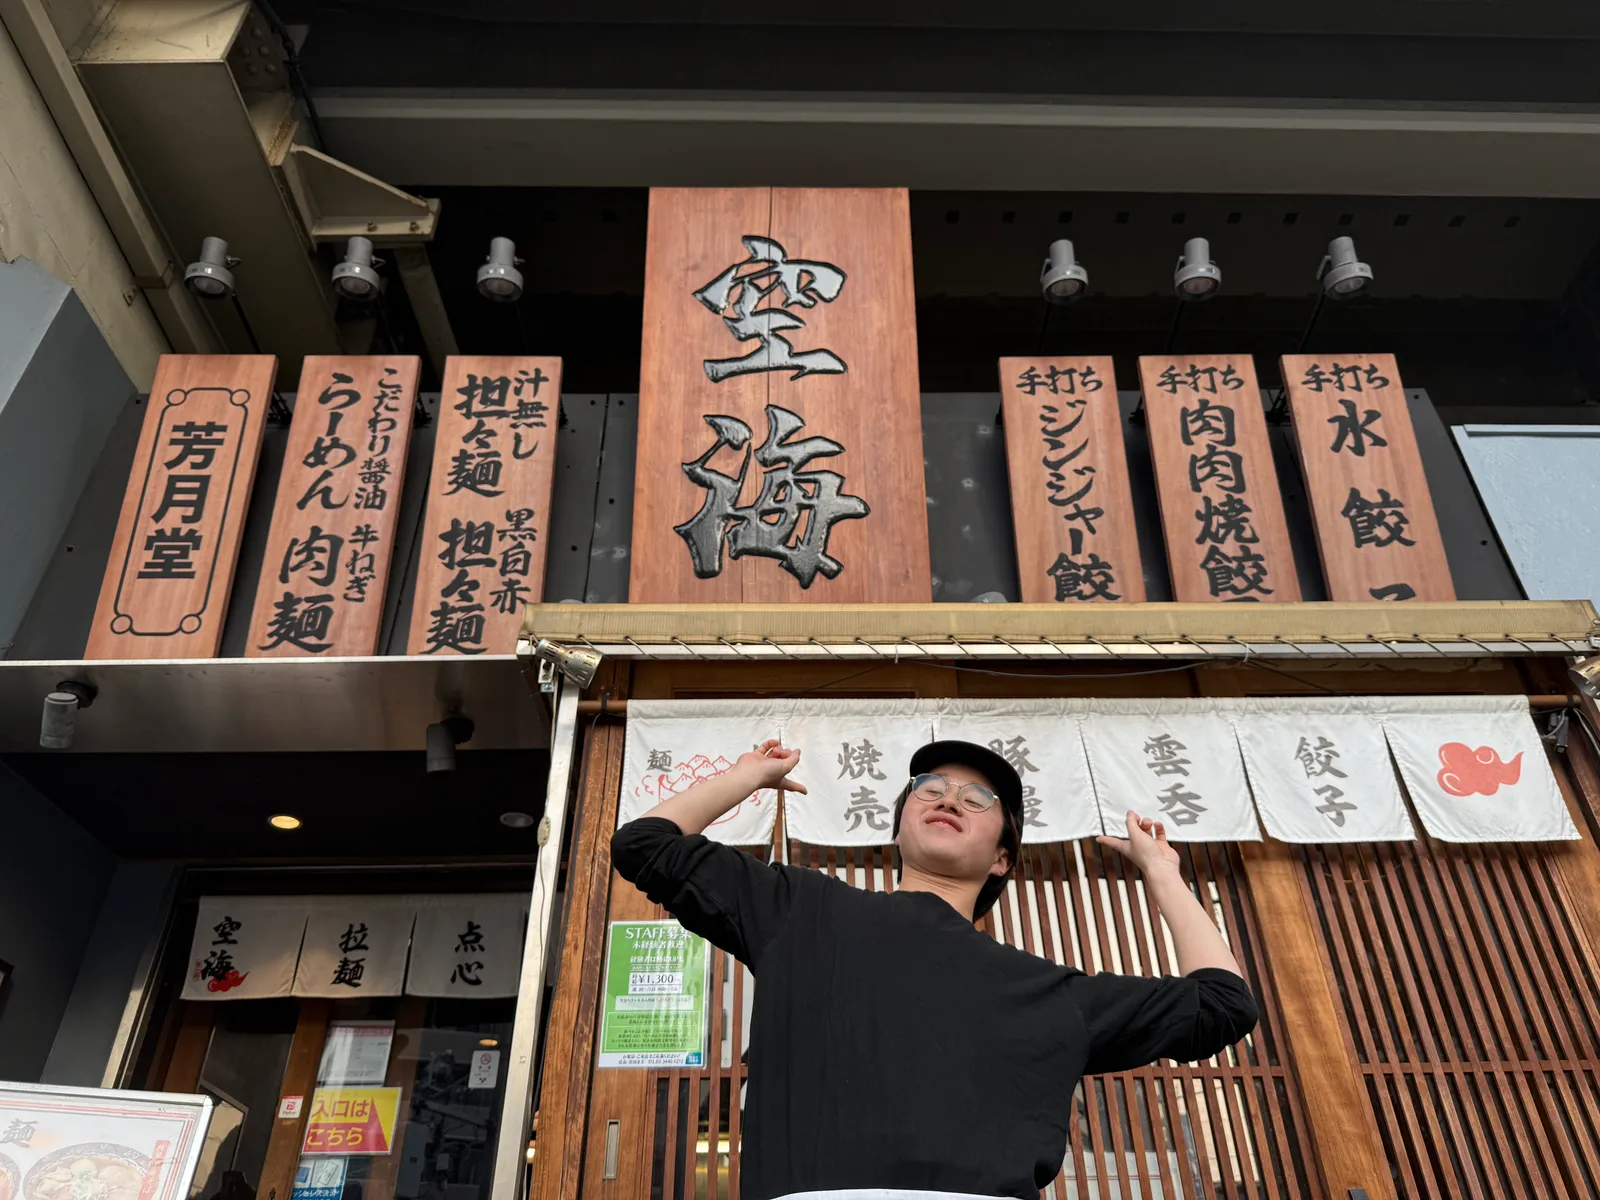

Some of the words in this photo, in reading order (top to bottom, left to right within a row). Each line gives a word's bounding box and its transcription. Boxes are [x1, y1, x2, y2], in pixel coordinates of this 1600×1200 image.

[510, 369, 550, 460] 汁無し
[673, 235, 870, 589] 空海
[1016, 366, 1104, 396] 手打ち
[1156, 364, 1245, 395] 手打ち
[1301, 363, 1390, 394] 手打ち
[297, 372, 361, 510] らーめん
[442, 374, 512, 498] 担々麺
[137, 421, 228, 579] 芳月堂
[1179, 399, 1274, 602] 肉肉焼餃
[257, 526, 344, 653] 肉麺
[343, 524, 379, 602] 牛ねぎ
[418, 518, 497, 654] 担々麺
[489, 508, 537, 614] 黒白赤
[837, 738, 892, 833] 焼売
[1143, 733, 1208, 827] 雲呑
[1294, 736, 1358, 828] 餃子
[200, 916, 242, 981] 空海
[330, 923, 370, 987] 拉麺
[450, 921, 485, 985] 点心
[306, 1127, 363, 1147] こちら
[311, 1100, 371, 1118] 入口は
